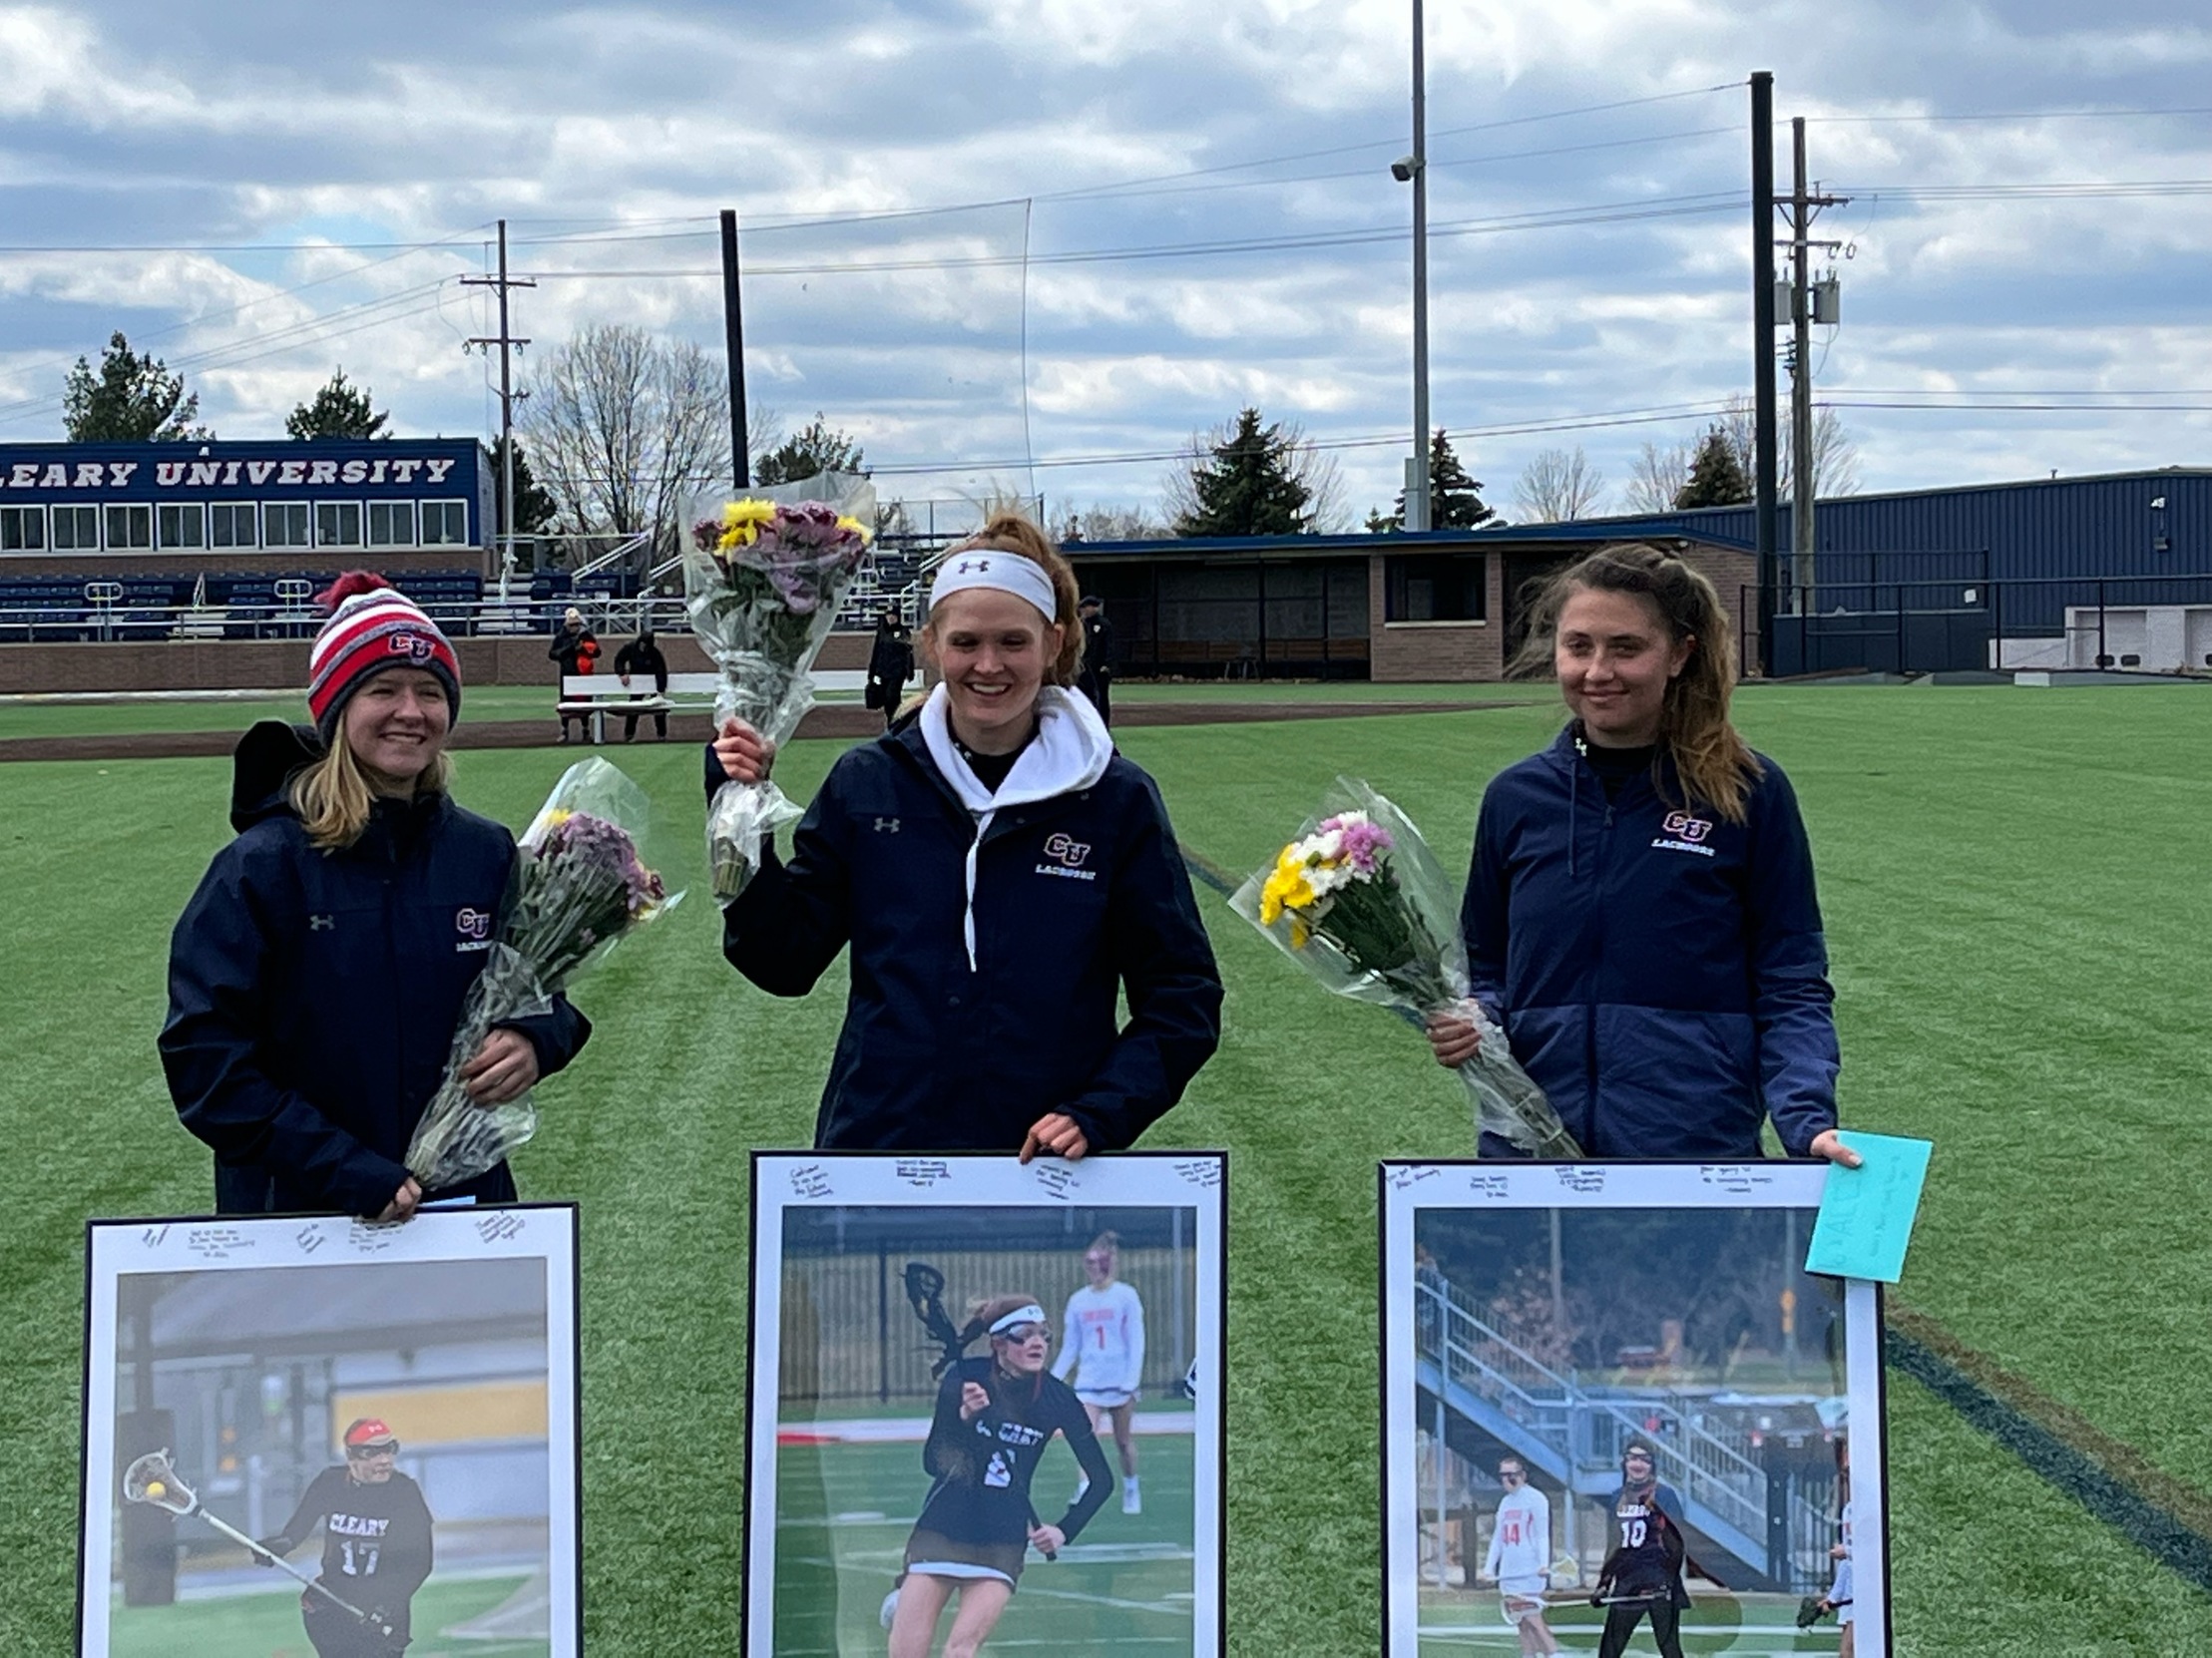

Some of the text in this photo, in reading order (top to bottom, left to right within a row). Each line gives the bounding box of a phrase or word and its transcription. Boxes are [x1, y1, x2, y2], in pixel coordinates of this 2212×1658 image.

[0, 459, 455, 488] EARY UNIVERSITY
[388, 631, 436, 665] CU
[1662, 810, 1713, 842] CU
[1043, 833, 1091, 867] CU
[456, 908, 490, 939] CU
[329, 1513, 389, 1536] CLEARY
[1620, 1520, 1647, 1548] 10
[341, 1541, 380, 1575] 17
